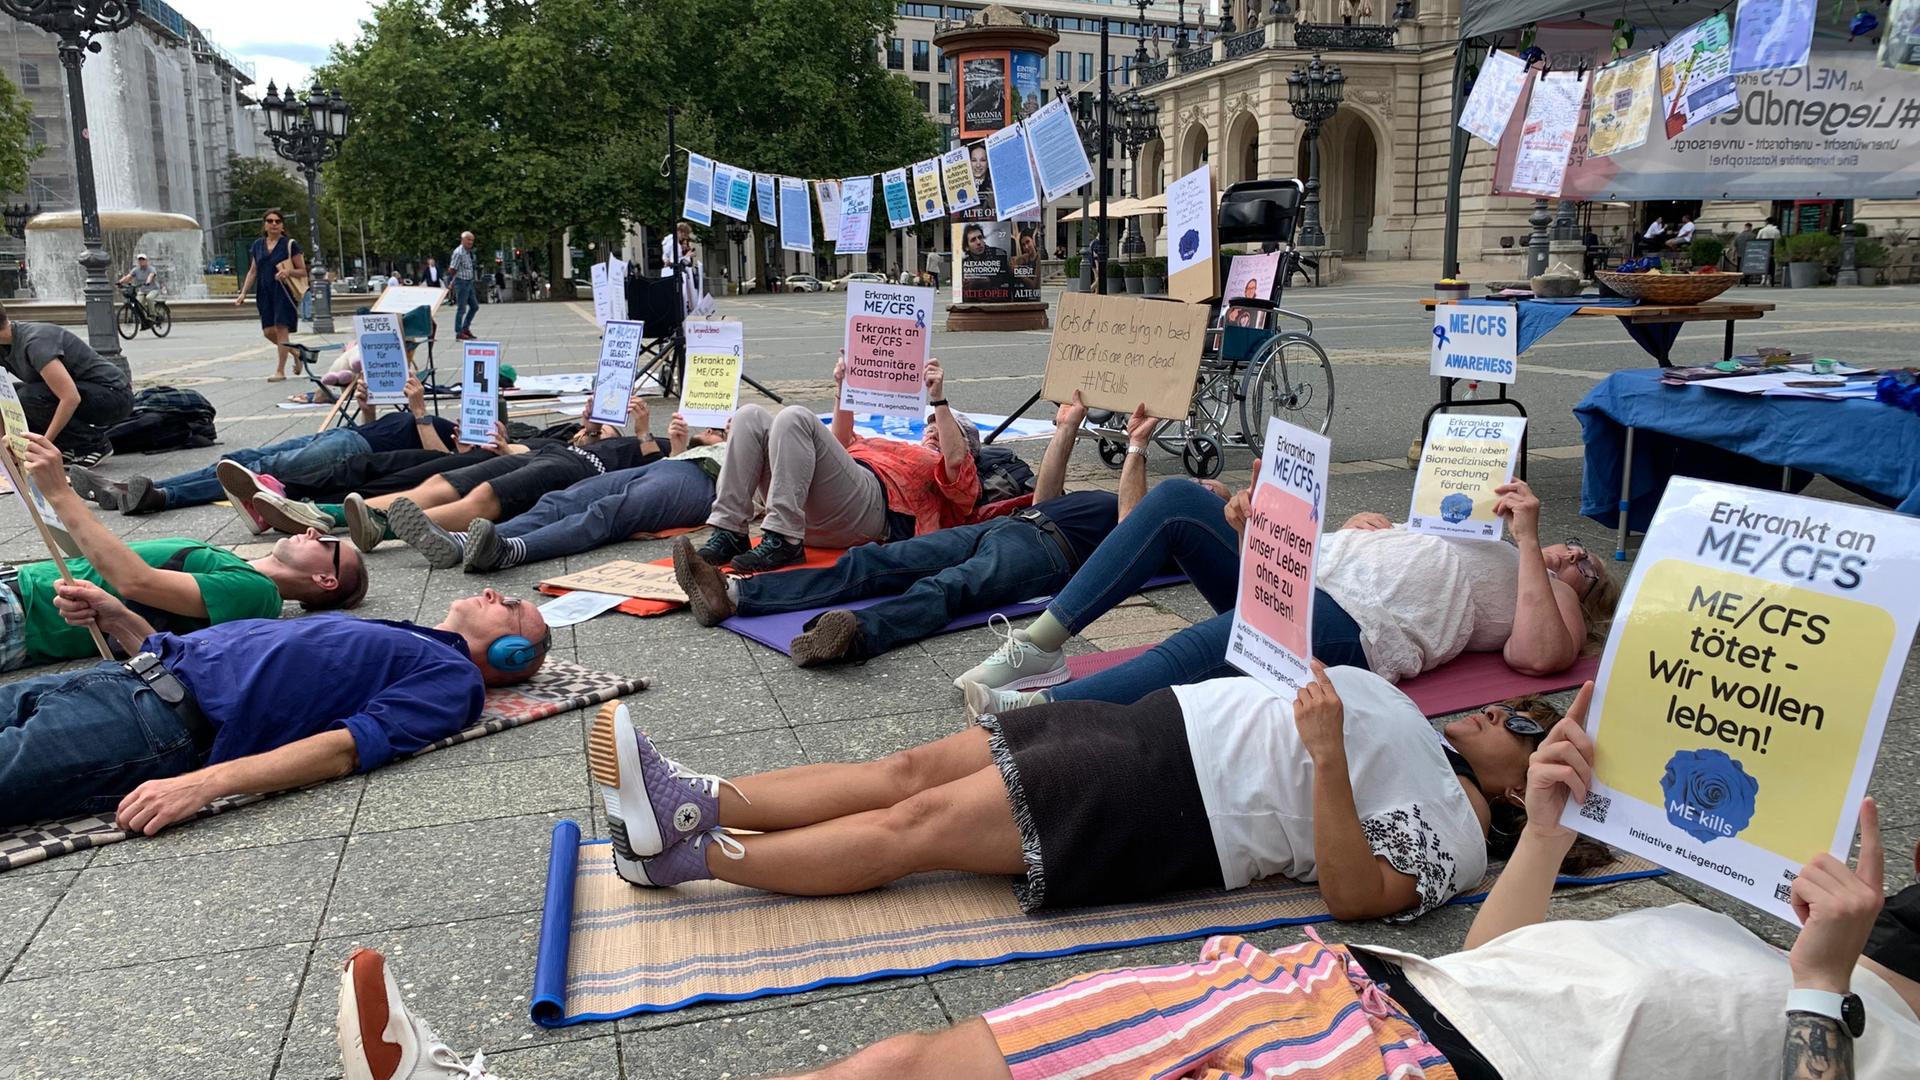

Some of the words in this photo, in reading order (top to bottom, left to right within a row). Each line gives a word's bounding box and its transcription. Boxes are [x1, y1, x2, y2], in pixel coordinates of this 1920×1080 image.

[963, 208, 983, 218] ALTE
[864, 290, 902, 302] Erkrankt
[903, 294, 916, 302] an
[985, 289, 1009, 298] OPER
[1014, 289, 1033, 298] ALTE
[864, 301, 915, 316] ME/CFS
[363, 323, 391, 332] ME/CFS
[856, 323, 902, 336] Erkrankt
[905, 328, 919, 337] an
[1128, 315, 1151, 345] lying
[1167, 321, 1191, 341] bed
[1449, 313, 1507, 337] ME/CFS
[361, 342, 401, 351] Versorgung
[861, 335, 903, 347] ME/CFS
[376, 351, 387, 360] für
[693, 355, 724, 365] Erkrankt
[725, 357, 736, 365] an
[872, 347, 895, 358] eine
[1148, 351, 1177, 369] dead
[367, 361, 401, 369] Schwerst-
[854, 356, 916, 370] humanitäre
[1444, 353, 1513, 375] AWARENESS
[696, 368, 725, 377] ME/CFS
[850, 367, 920, 382] Katastrophe!
[379, 379, 395, 387] fehlt
[703, 380, 719, 388] eine
[1080, 370, 1129, 395] #MEkills
[688, 389, 731, 400] humanitäre
[684, 400, 732, 413] Katastrophe!
[1449, 417, 1490, 427] Erkrankt
[1446, 427, 1502, 439] ME/CFS
[1276, 435, 1306, 463] Erkrankt
[1306, 452, 1316, 466] an
[1431, 443, 1445, 452] Wir
[1448, 445, 1477, 454] wollen
[1480, 446, 1508, 455] leben!
[1425, 454, 1508, 469] Biomedizinische
[1273, 454, 1314, 494] ME/CFS
[1434, 466, 1489, 481] Forschung
[1440, 480, 1481, 492] fördern
[1251, 507, 1268, 532] Wir
[1269, 518, 1313, 558] verlieren
[1708, 499, 1831, 544] Erkrankt
[1835, 529, 1877, 554] an
[1249, 535, 1275, 560] unser
[1276, 548, 1308, 582] Leben
[1696, 525, 1868, 591] ME/CFS
[1256, 561, 1280, 589] ohne
[1281, 580, 1294, 598] zu
[1254, 585, 1295, 623] sterben!
[1687, 584, 1831, 646] ME/CFS
[1689, 625, 1777, 674] tötet
[1784, 662, 1800, 672] -
[1243, 647, 1267, 670] Initiative
[1647, 649, 1704, 690] Wir
[1709, 674, 1826, 731] wollen
[1665, 693, 1773, 756] leben!
[1668, 799, 1696, 822] ME
[1698, 810, 1734, 837] kills
[1628, 826, 1674, 853] Initiative
[1674, 845, 1756, 887] #LiegendDemo
